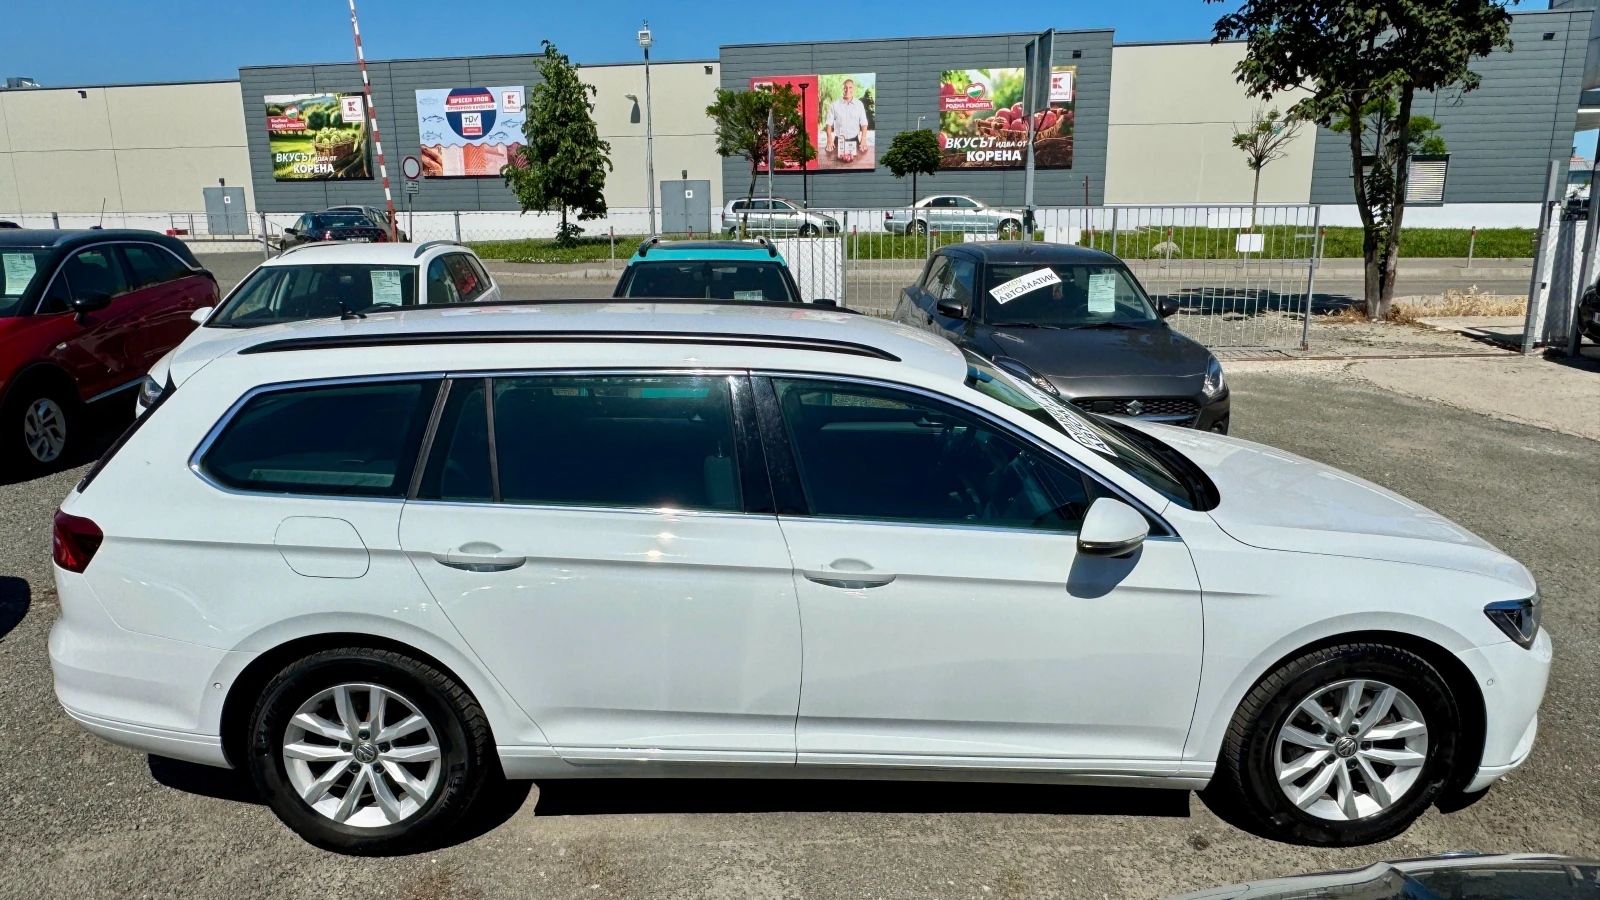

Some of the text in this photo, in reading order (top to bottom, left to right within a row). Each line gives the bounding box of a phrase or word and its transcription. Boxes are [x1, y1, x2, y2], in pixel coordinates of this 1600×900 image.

[945, 137, 996, 149] ВКУСЪТ
[276, 152, 313, 163] ВКУСЪТ
[966, 150, 1022, 162] КОРЕНА
[293, 164, 335, 174] КОРЕНА
[1000, 273, 1057, 302] АВТОМАТИК
